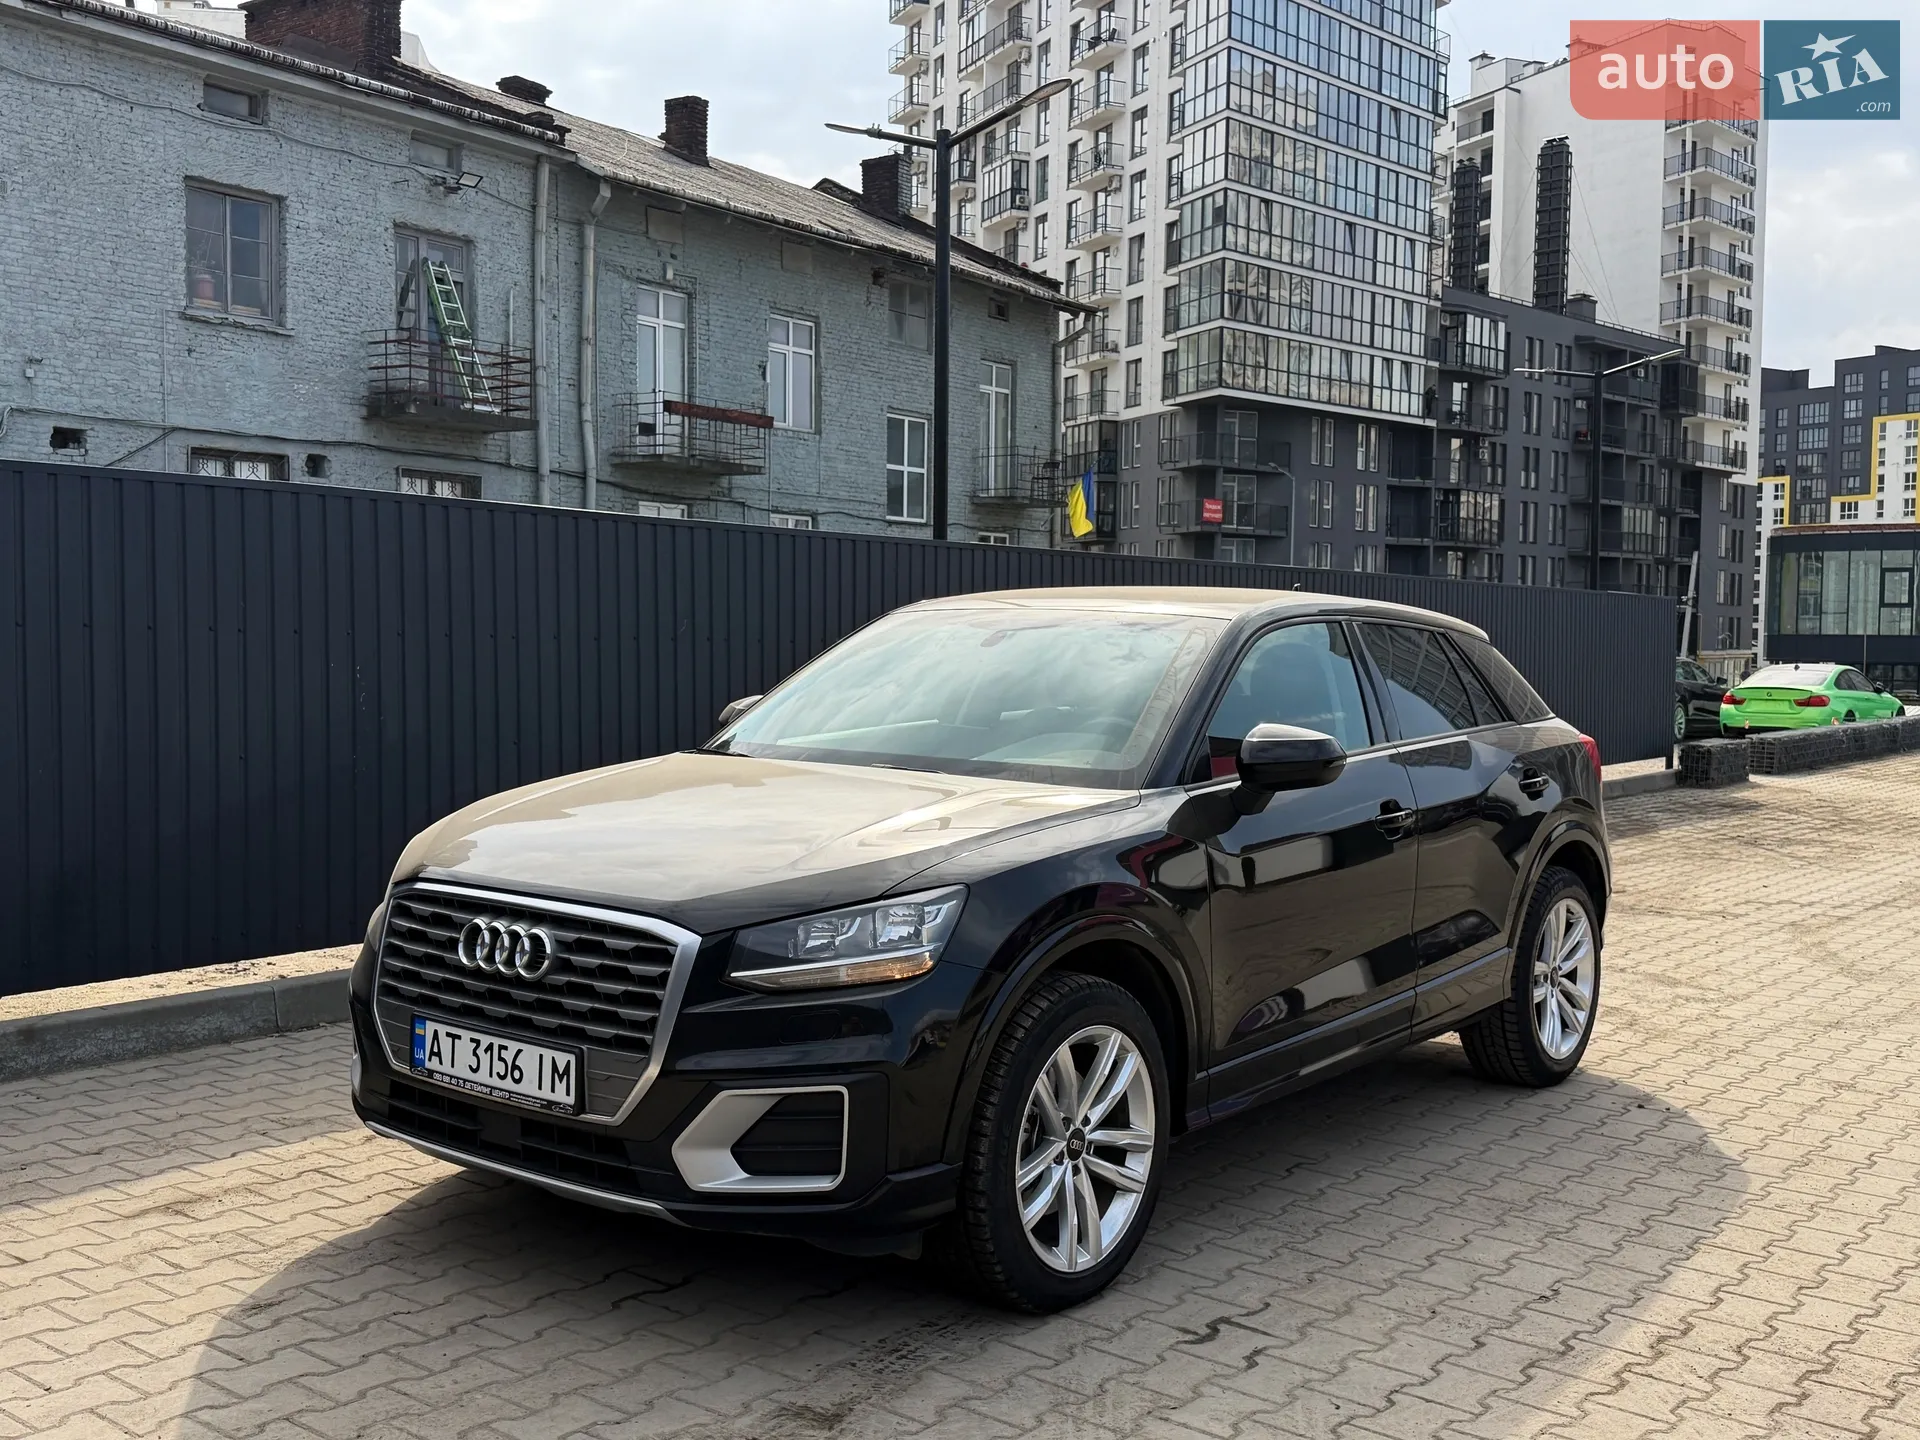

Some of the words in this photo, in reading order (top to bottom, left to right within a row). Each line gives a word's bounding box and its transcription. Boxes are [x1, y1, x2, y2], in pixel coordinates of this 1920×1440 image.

[414, 1047, 425, 1060] UA
[427, 1028, 462, 1069] AT
[468, 1036, 524, 1085] 3156
[537, 1053, 571, 1097] IM
